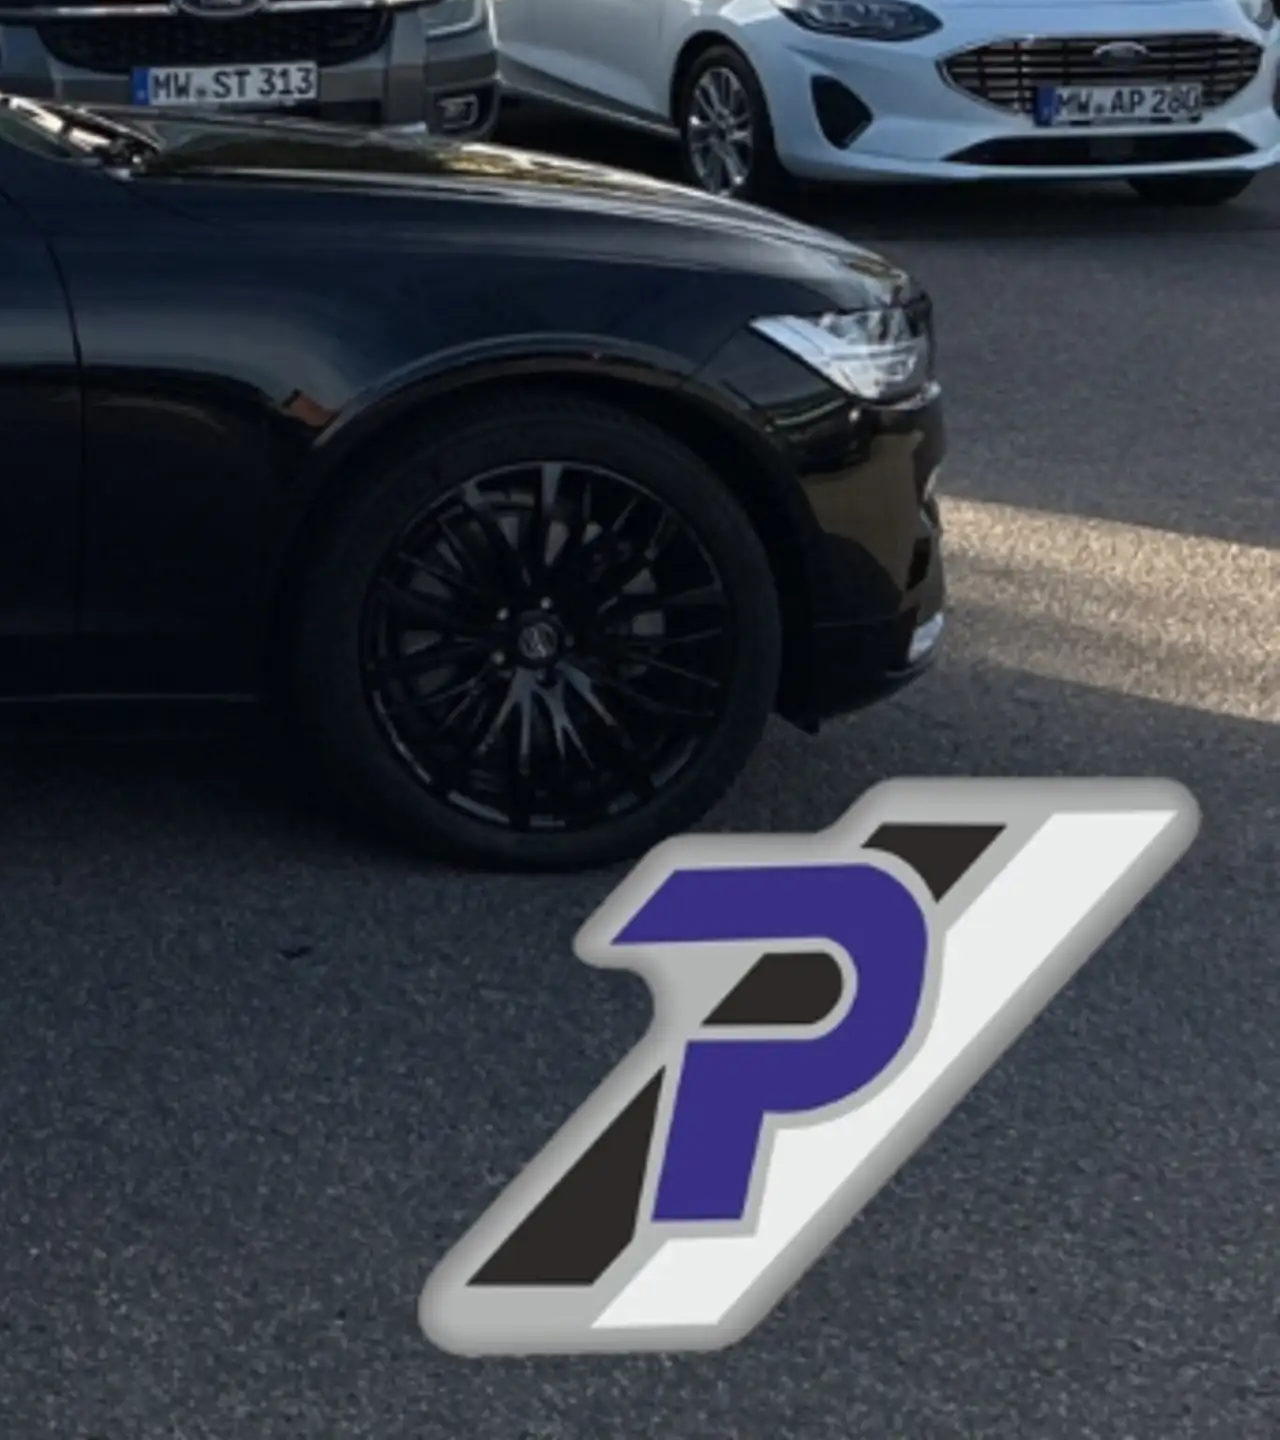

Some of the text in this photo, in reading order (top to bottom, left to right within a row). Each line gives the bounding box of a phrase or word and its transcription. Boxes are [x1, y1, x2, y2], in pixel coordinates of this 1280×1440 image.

[152, 71, 192, 100] MW
[212, 69, 251, 99] ST
[258, 66, 314, 97] 313
[1111, 88, 1146, 113] AP
